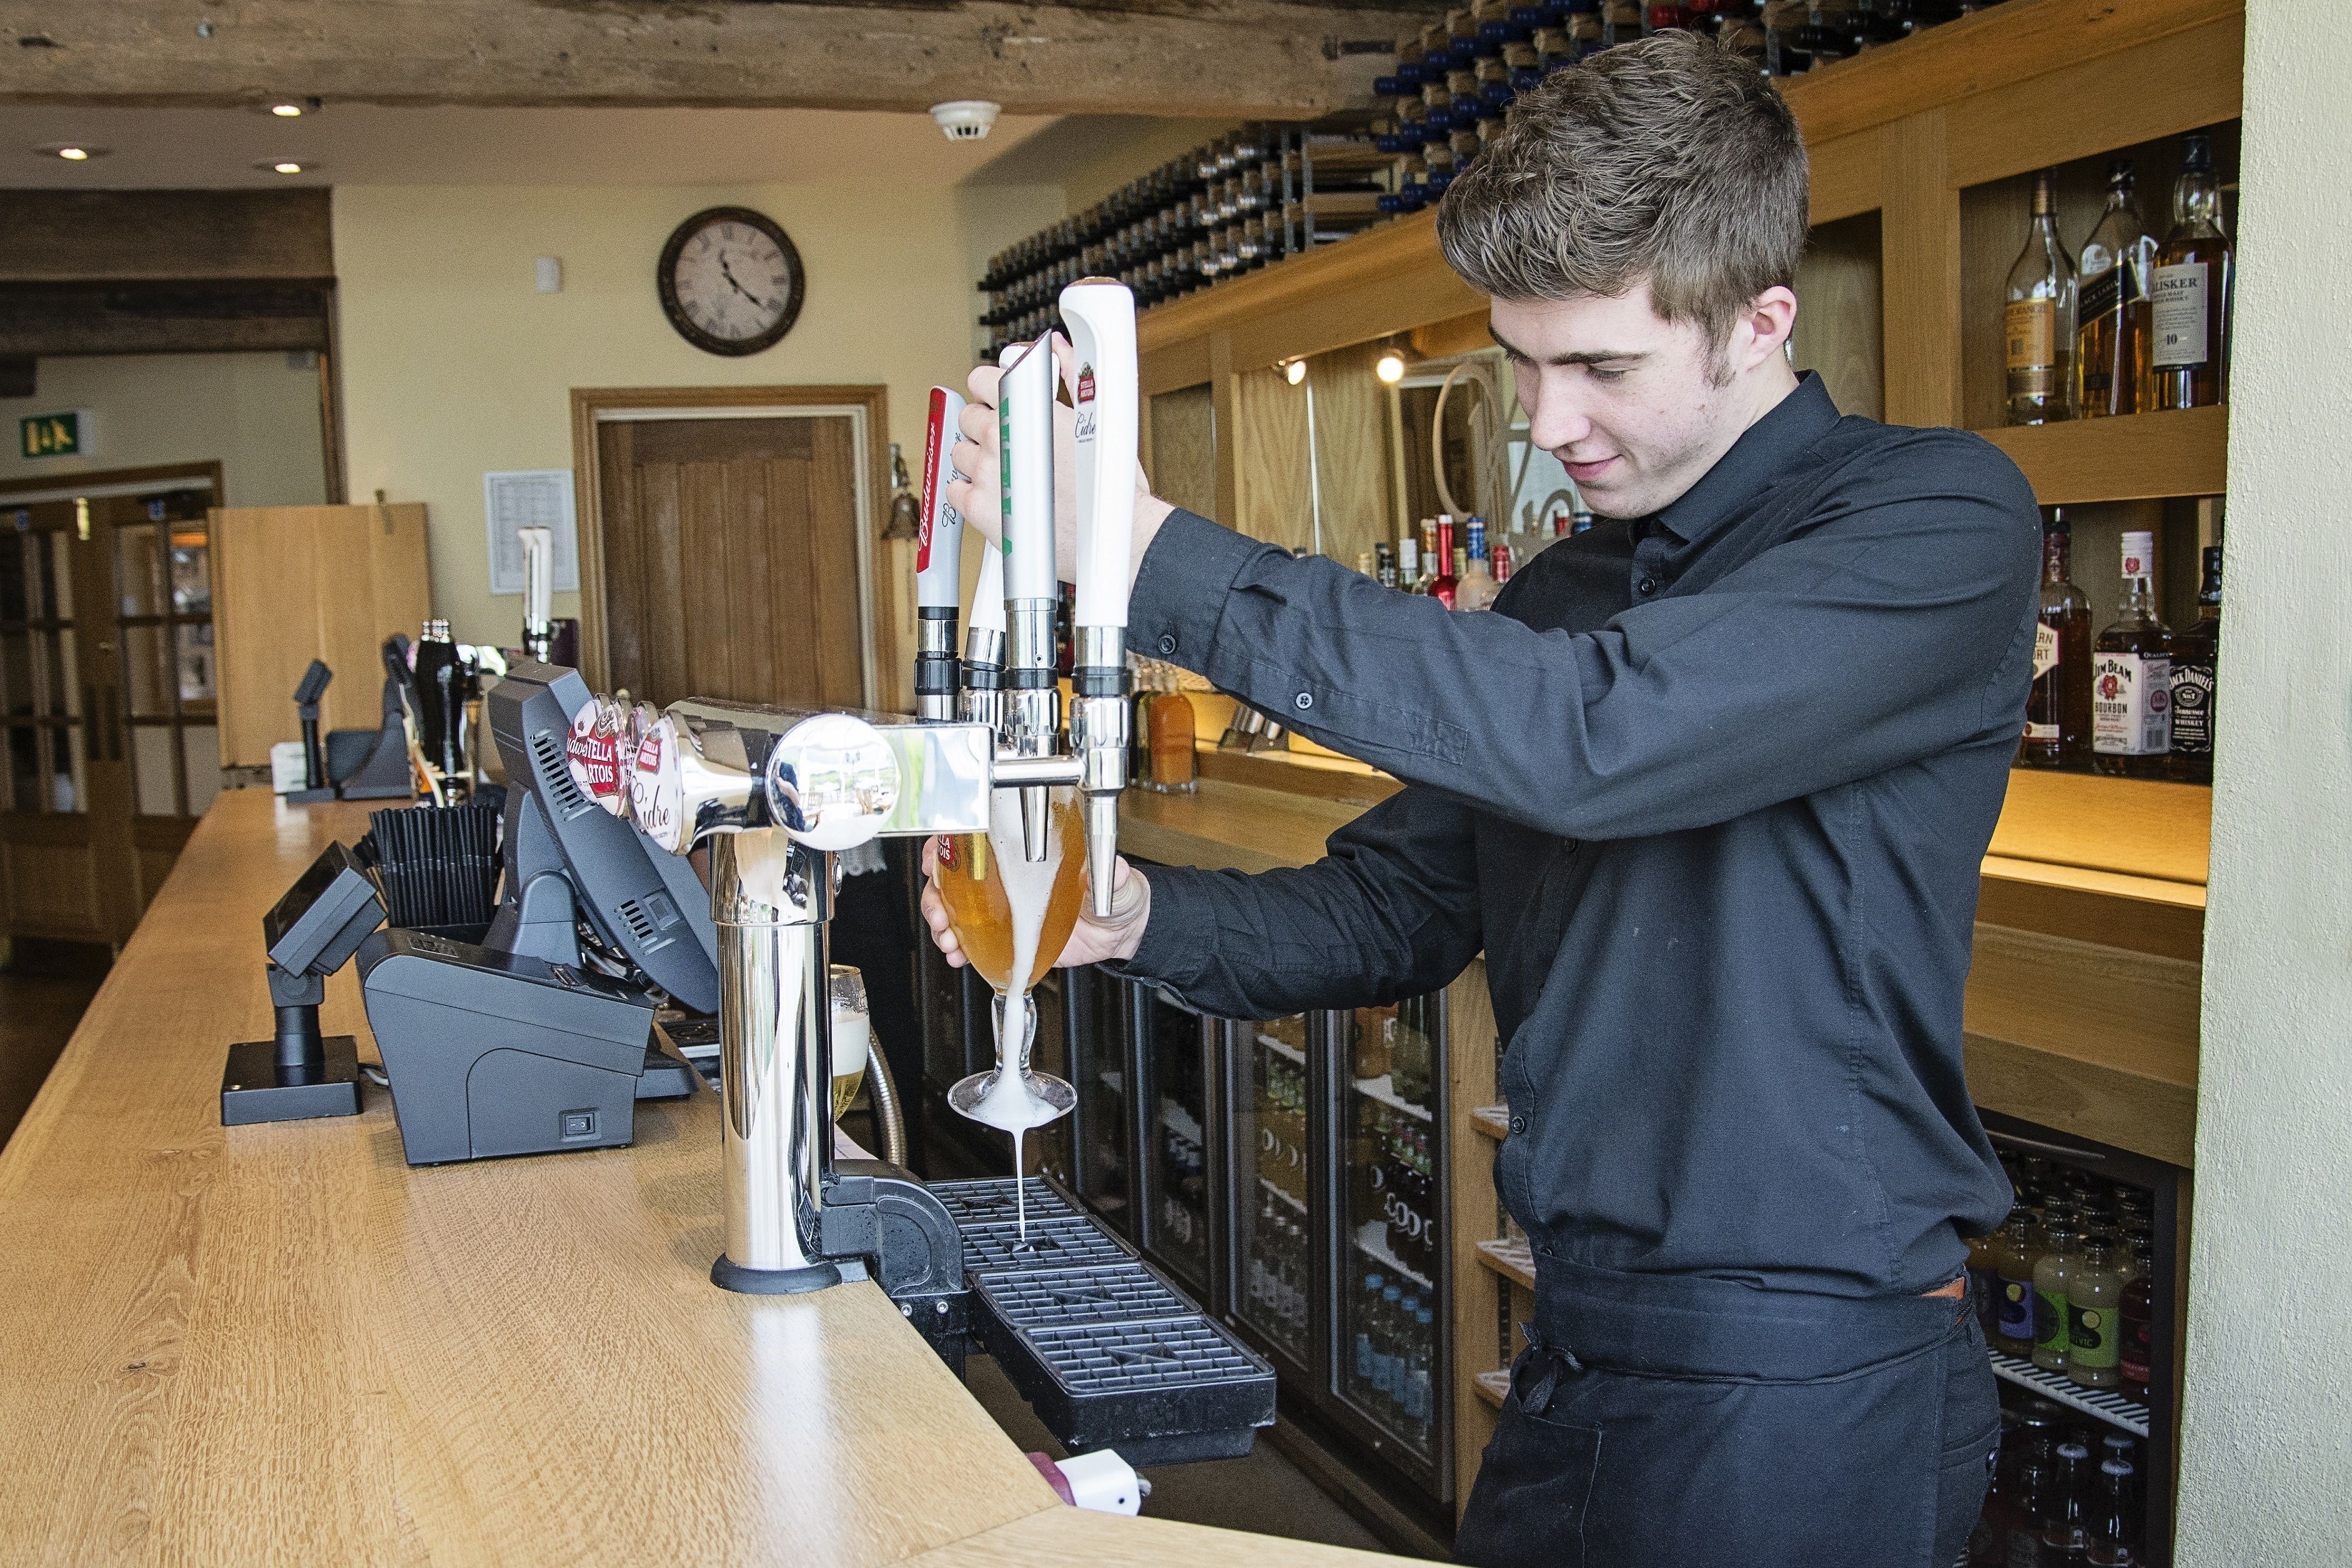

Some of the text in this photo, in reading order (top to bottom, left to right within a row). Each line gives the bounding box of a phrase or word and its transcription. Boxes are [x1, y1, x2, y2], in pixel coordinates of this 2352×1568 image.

[2167, 333, 2178, 345] 10
[1080, 379, 1094, 390] STELLA
[1075, 412, 1096, 438] Cidre
[919, 422, 935, 551] Budweiser
[2095, 662, 2107, 677] JIM
[2108, 659, 2132, 683] BEAM
[2169, 672, 2185, 691] JACK
[2095, 702, 2128, 714] BOURBON
[2175, 718, 2203, 727] WHISKEY
[643, 740, 659, 754] STELLA
[640, 751, 658, 767] ARTOIS
